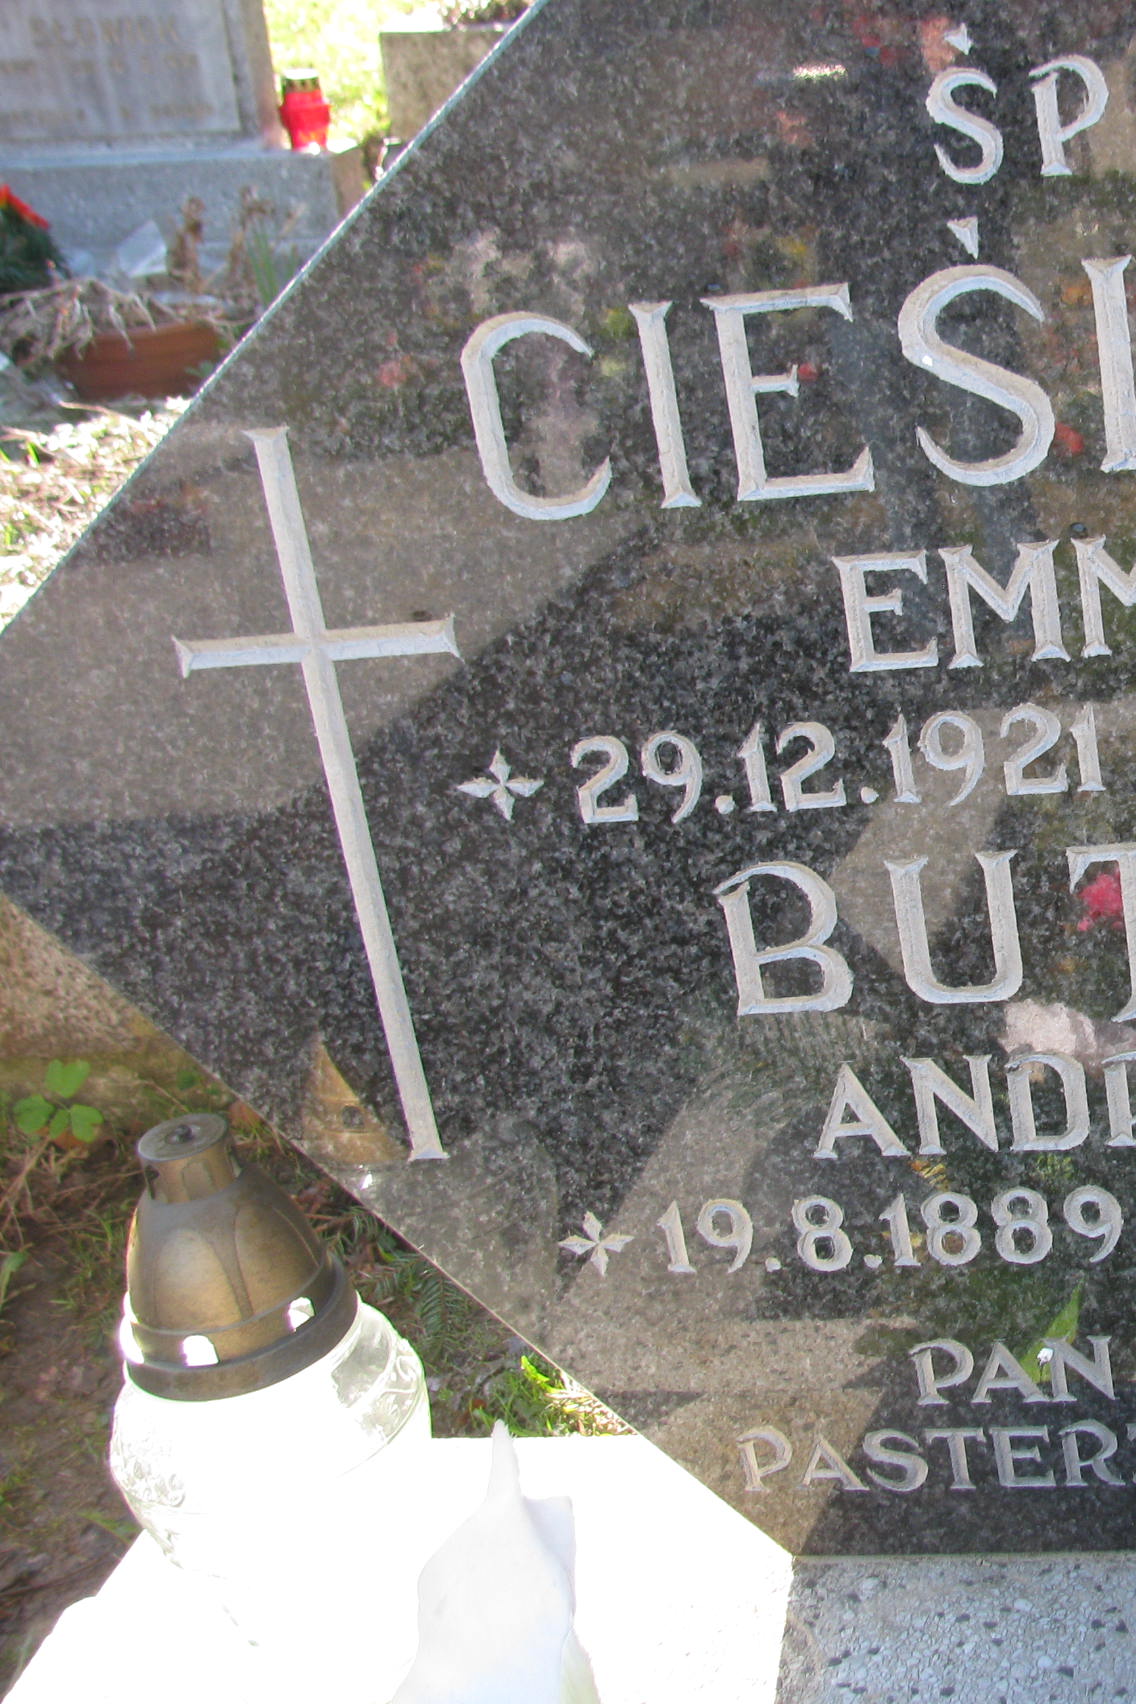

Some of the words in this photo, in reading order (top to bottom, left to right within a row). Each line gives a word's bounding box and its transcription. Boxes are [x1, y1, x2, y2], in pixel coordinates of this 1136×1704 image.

[571, 704, 1106, 824] 29.12.1921
[659, 1184, 1124, 1274] 19.8.1889
[909, 1336, 1117, 1405] PAN
